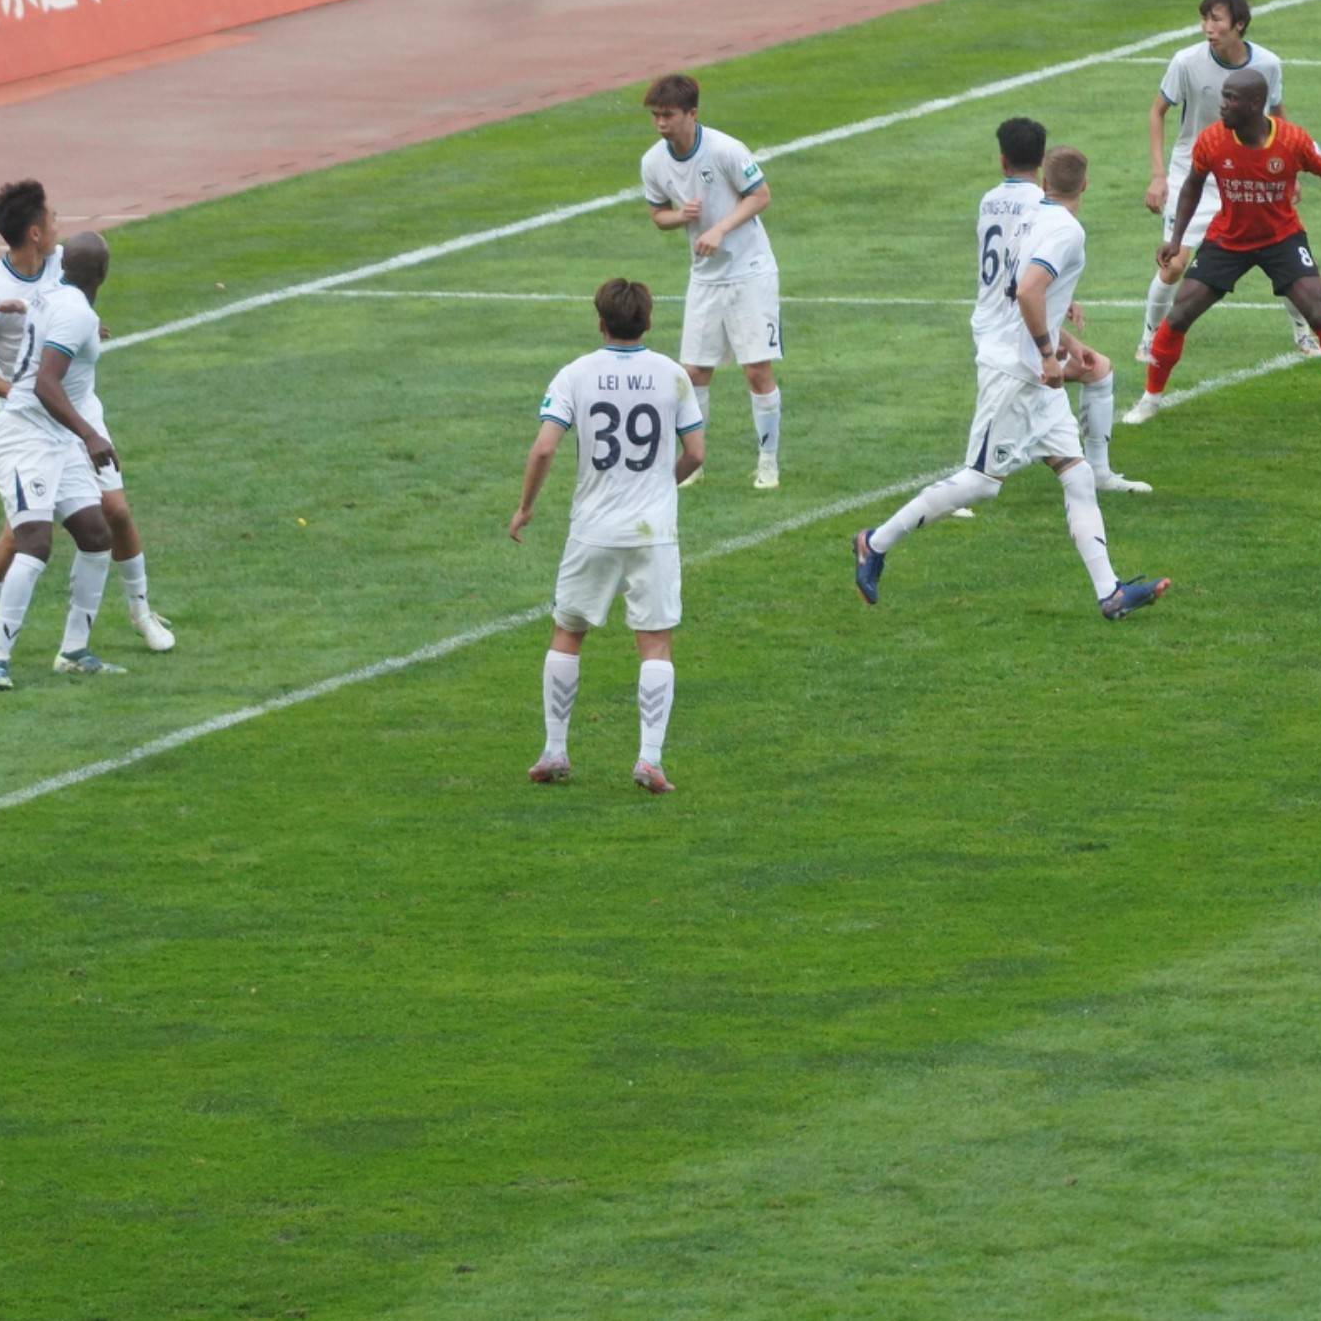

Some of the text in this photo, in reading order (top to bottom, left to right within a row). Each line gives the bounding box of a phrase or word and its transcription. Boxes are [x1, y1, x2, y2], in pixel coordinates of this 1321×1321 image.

[981, 224, 1003, 286] 6
[1297, 246, 1315, 268] 8
[597, 374, 656, 391] LEI W.J.
[589, 401, 662, 472] 39
